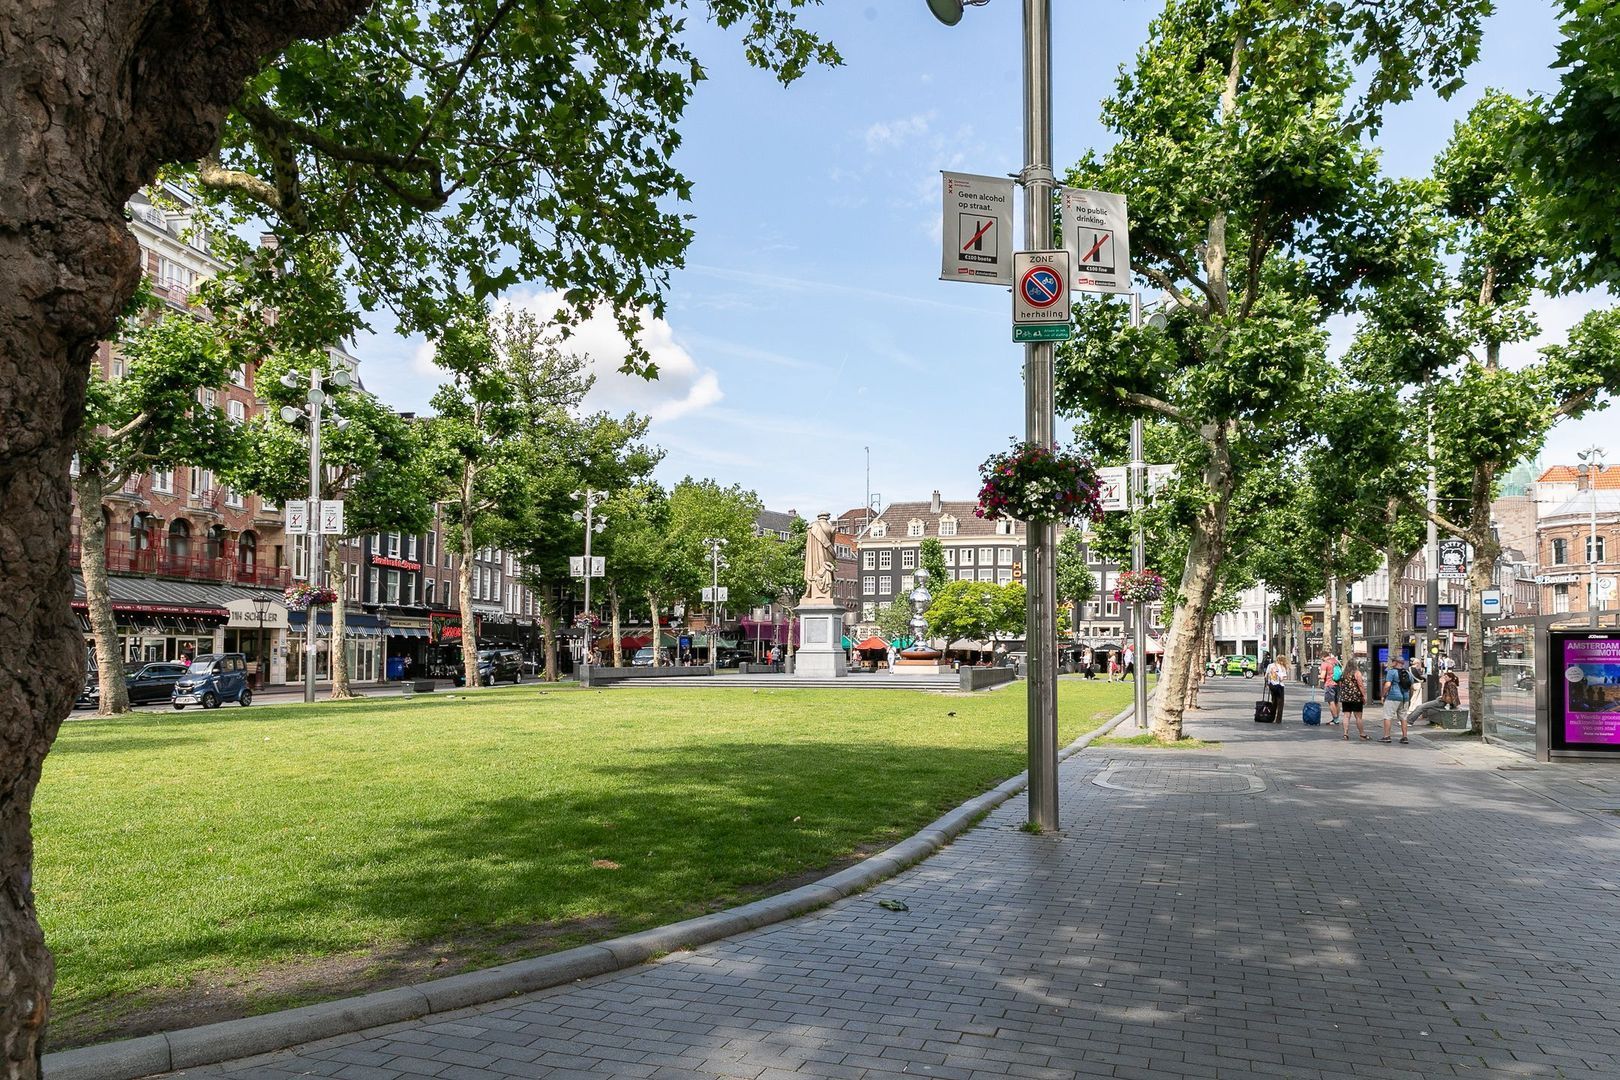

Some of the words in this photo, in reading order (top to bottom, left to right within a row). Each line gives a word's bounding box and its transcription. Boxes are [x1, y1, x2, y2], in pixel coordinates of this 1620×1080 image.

[958, 191, 978, 200] Geen
[979, 193, 1005, 203] alcohol
[970, 203, 993, 211] straat.
[1087, 208, 1108, 216] public
[1076, 215, 1106, 226] drinking.
[1020, 310, 1063, 319] herhaling
[1015, 329, 1023, 338] P
[1567, 642, 1620, 650] AMSTERDAM
[1600, 649, 1620, 657] MOTI
